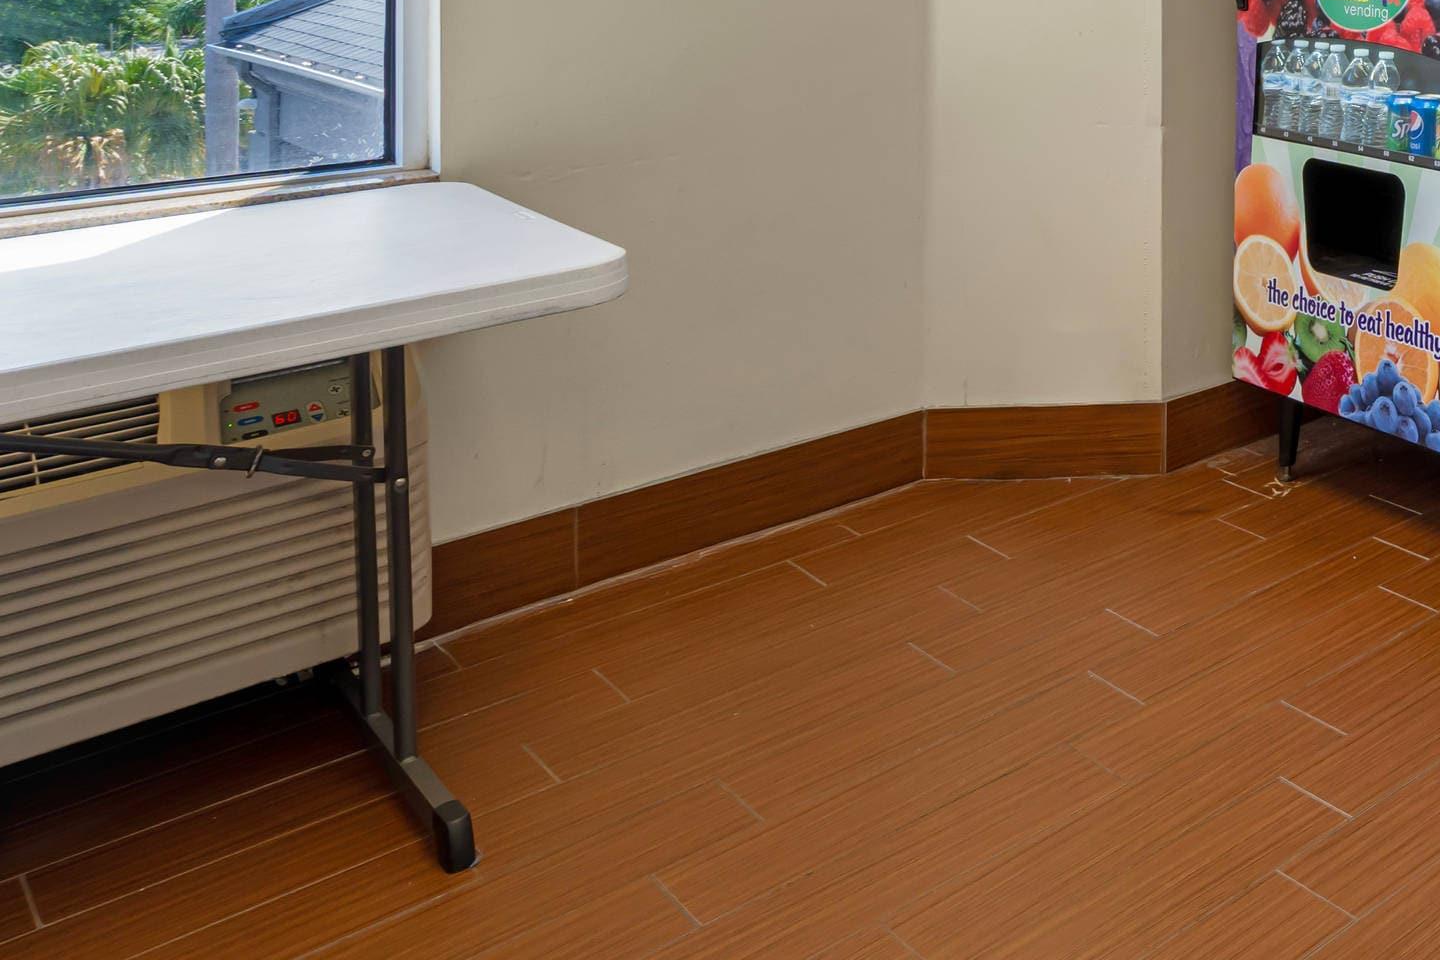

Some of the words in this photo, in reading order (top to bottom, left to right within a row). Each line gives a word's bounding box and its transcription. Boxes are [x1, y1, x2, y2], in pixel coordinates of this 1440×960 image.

[1344, 4, 1389, 22] vending
[1267, 278, 1289, 307] the
[1292, 286, 1336, 321] choice
[1339, 301, 1354, 326] to
[1358, 311, 1382, 336] eat
[275, 411, 297, 425] 60
